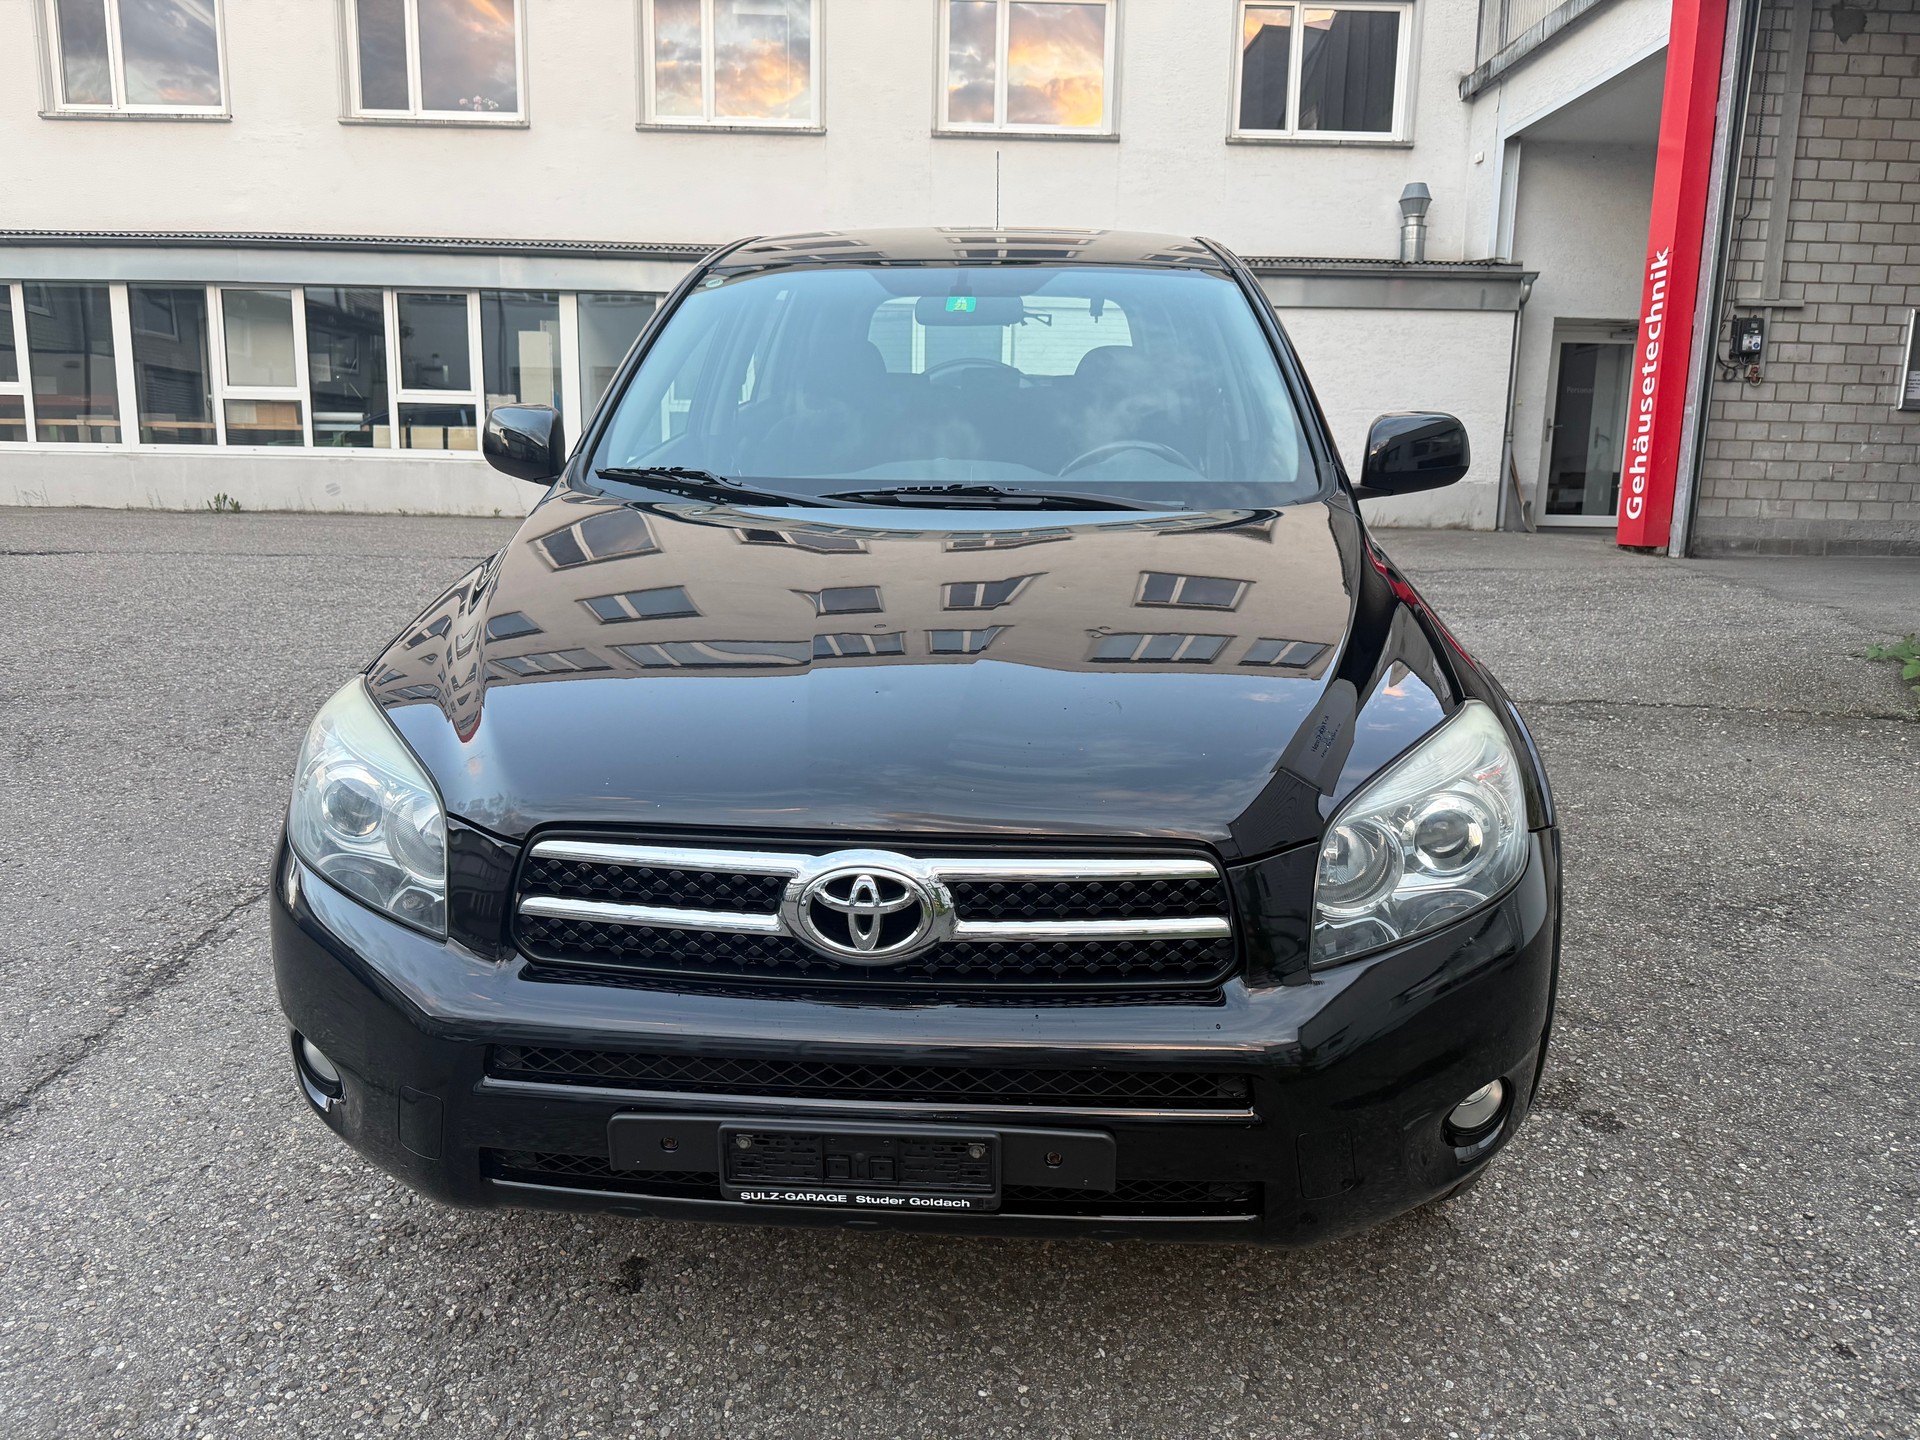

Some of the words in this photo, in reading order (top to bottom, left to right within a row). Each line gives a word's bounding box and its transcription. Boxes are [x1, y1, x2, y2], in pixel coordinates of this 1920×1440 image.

[1626, 246, 1669, 520] Gehäusetechnik
[740, 1191, 848, 1203] SULZ-GARAGE
[855, 1195, 905, 1206] Studer
[909, 1197, 971, 1208] Goldach
